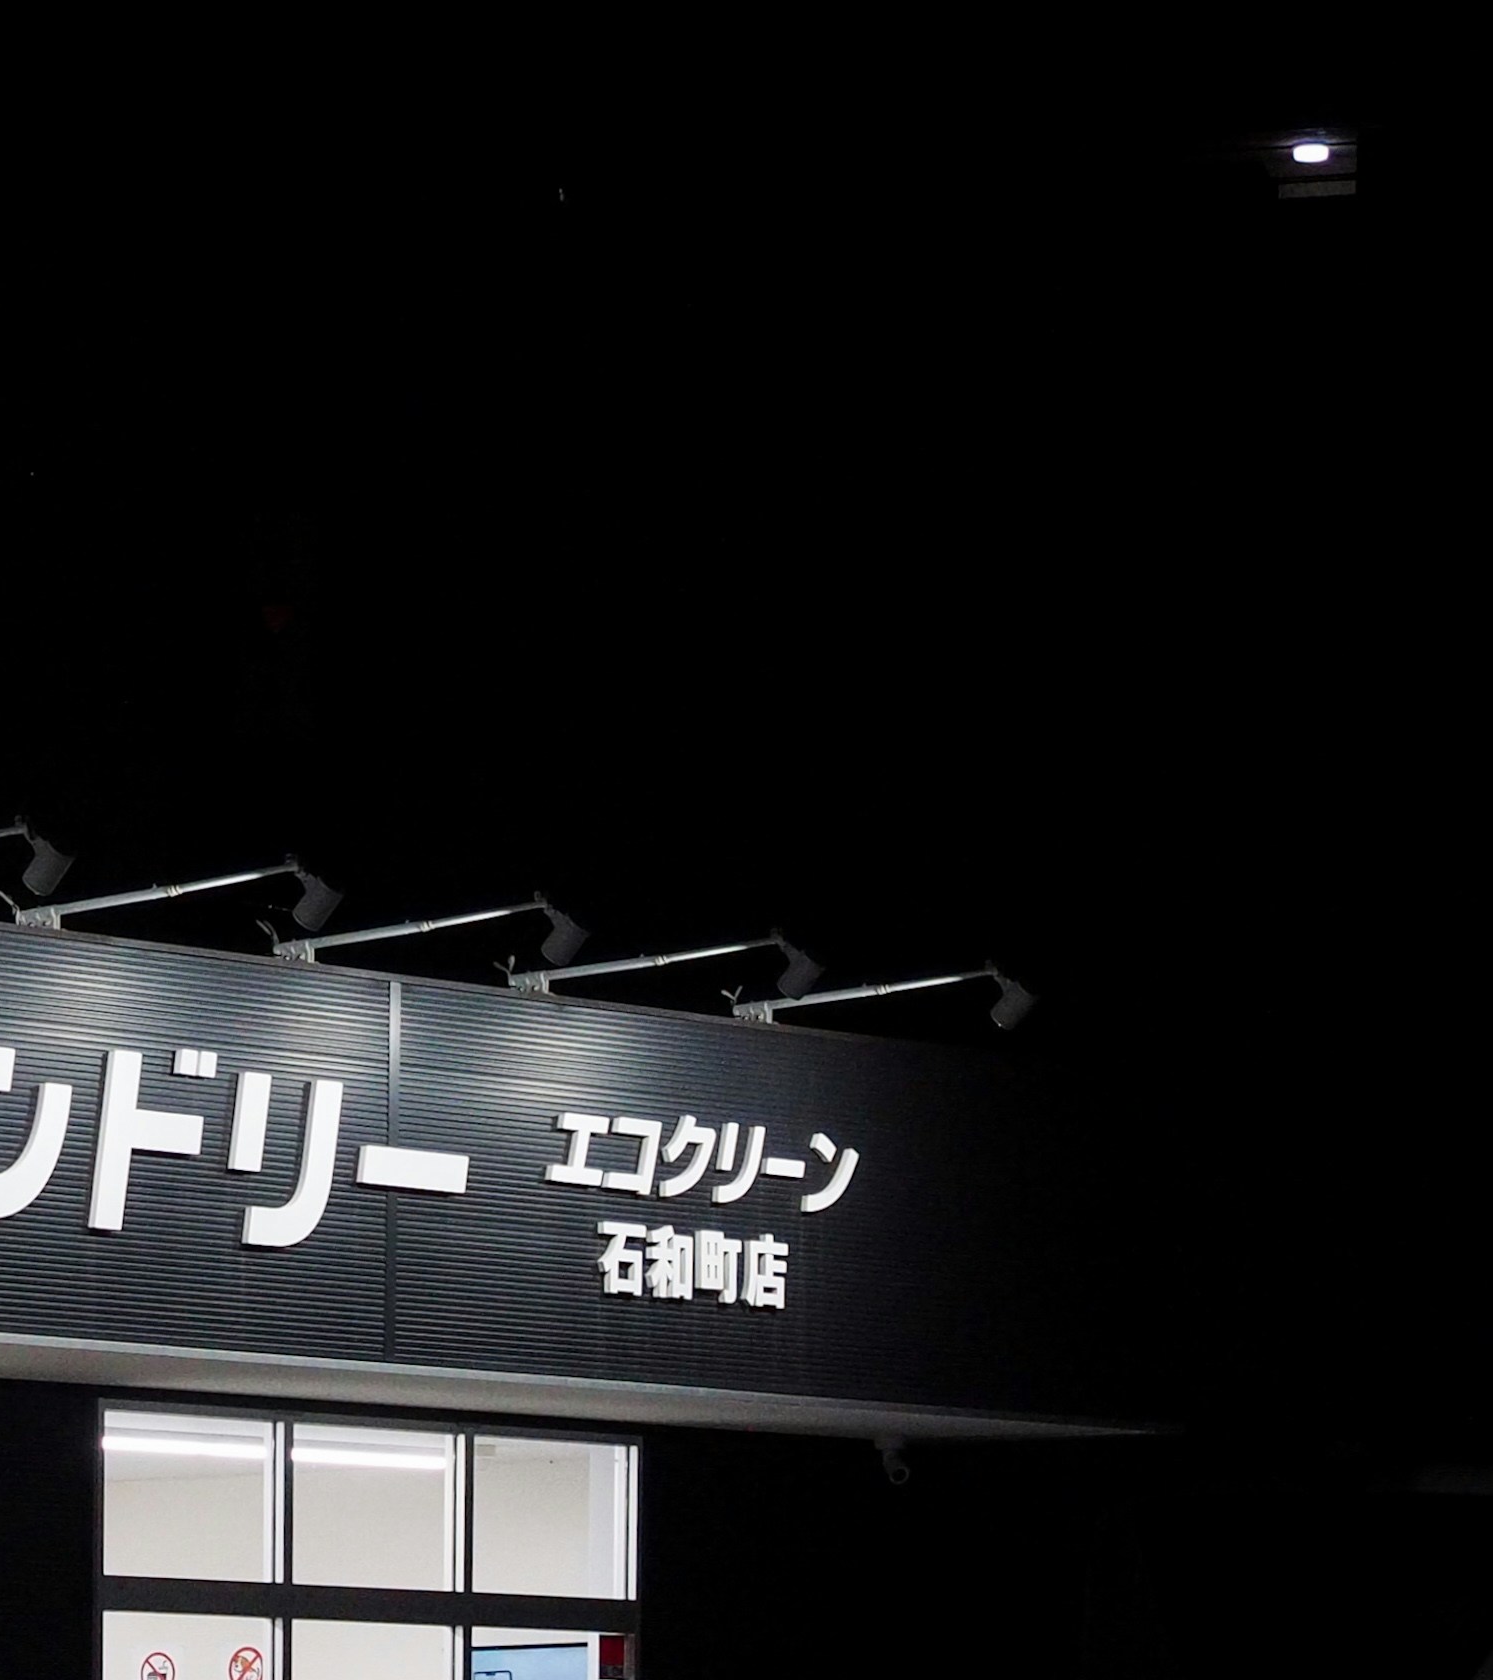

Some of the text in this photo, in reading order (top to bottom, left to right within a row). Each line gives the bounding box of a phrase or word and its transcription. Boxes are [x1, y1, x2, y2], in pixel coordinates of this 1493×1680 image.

[544, 1112, 861, 1213] エコクリーン
[597, 1221, 790, 1310] 石和町店
